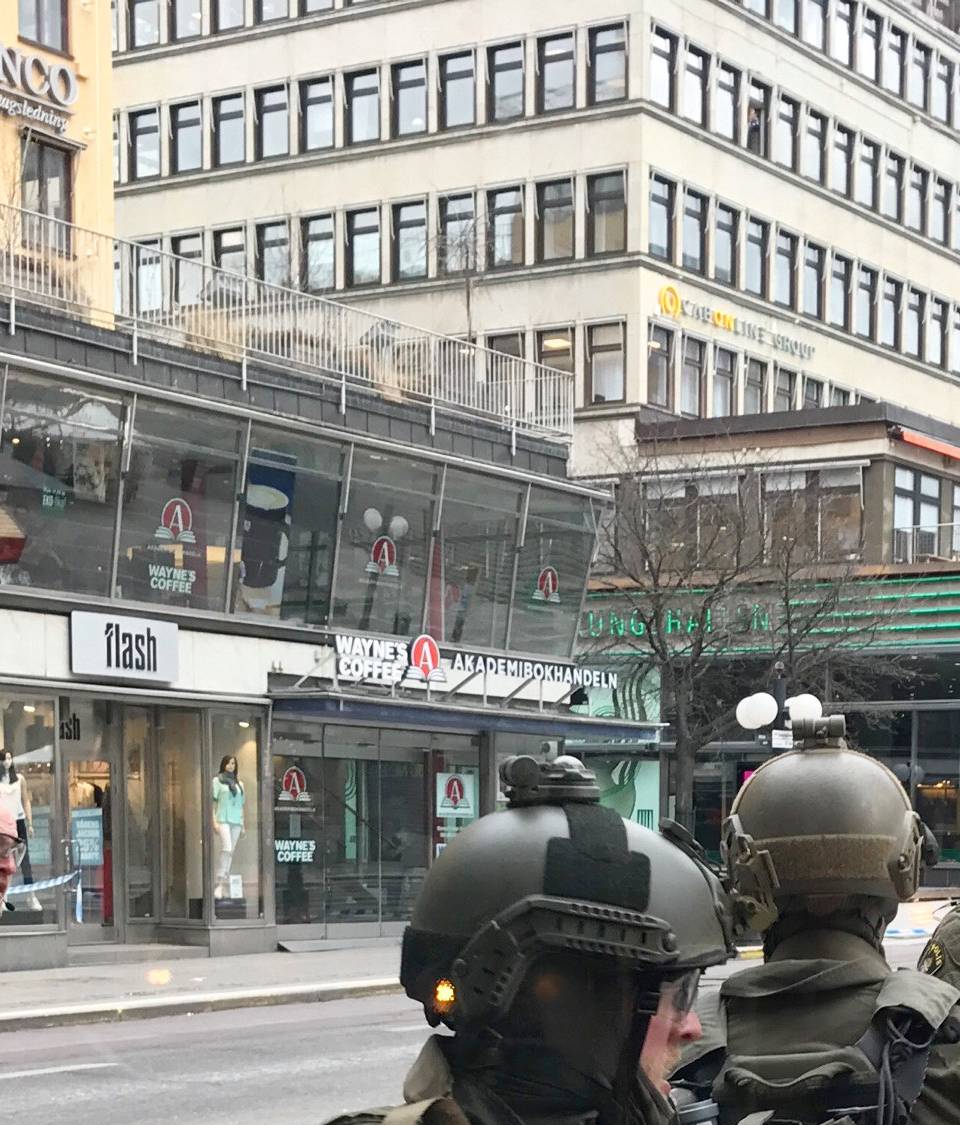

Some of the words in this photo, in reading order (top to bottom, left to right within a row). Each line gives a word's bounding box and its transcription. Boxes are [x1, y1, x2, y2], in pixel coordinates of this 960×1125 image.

[774, 333, 815, 361] GROUP
[148, 563, 197, 582] WAYNE'S
[150, 576, 192, 594] COFFEE
[104, 622, 157, 672] flash
[335, 634, 409, 666] WAYNE'S
[338, 657, 403, 682] COFFEE
[452, 653, 618, 690] AKADEMIBOKHANDELN
[274, 839, 316, 851] WAYNE'S
[277, 850, 313, 862] COFFEE
